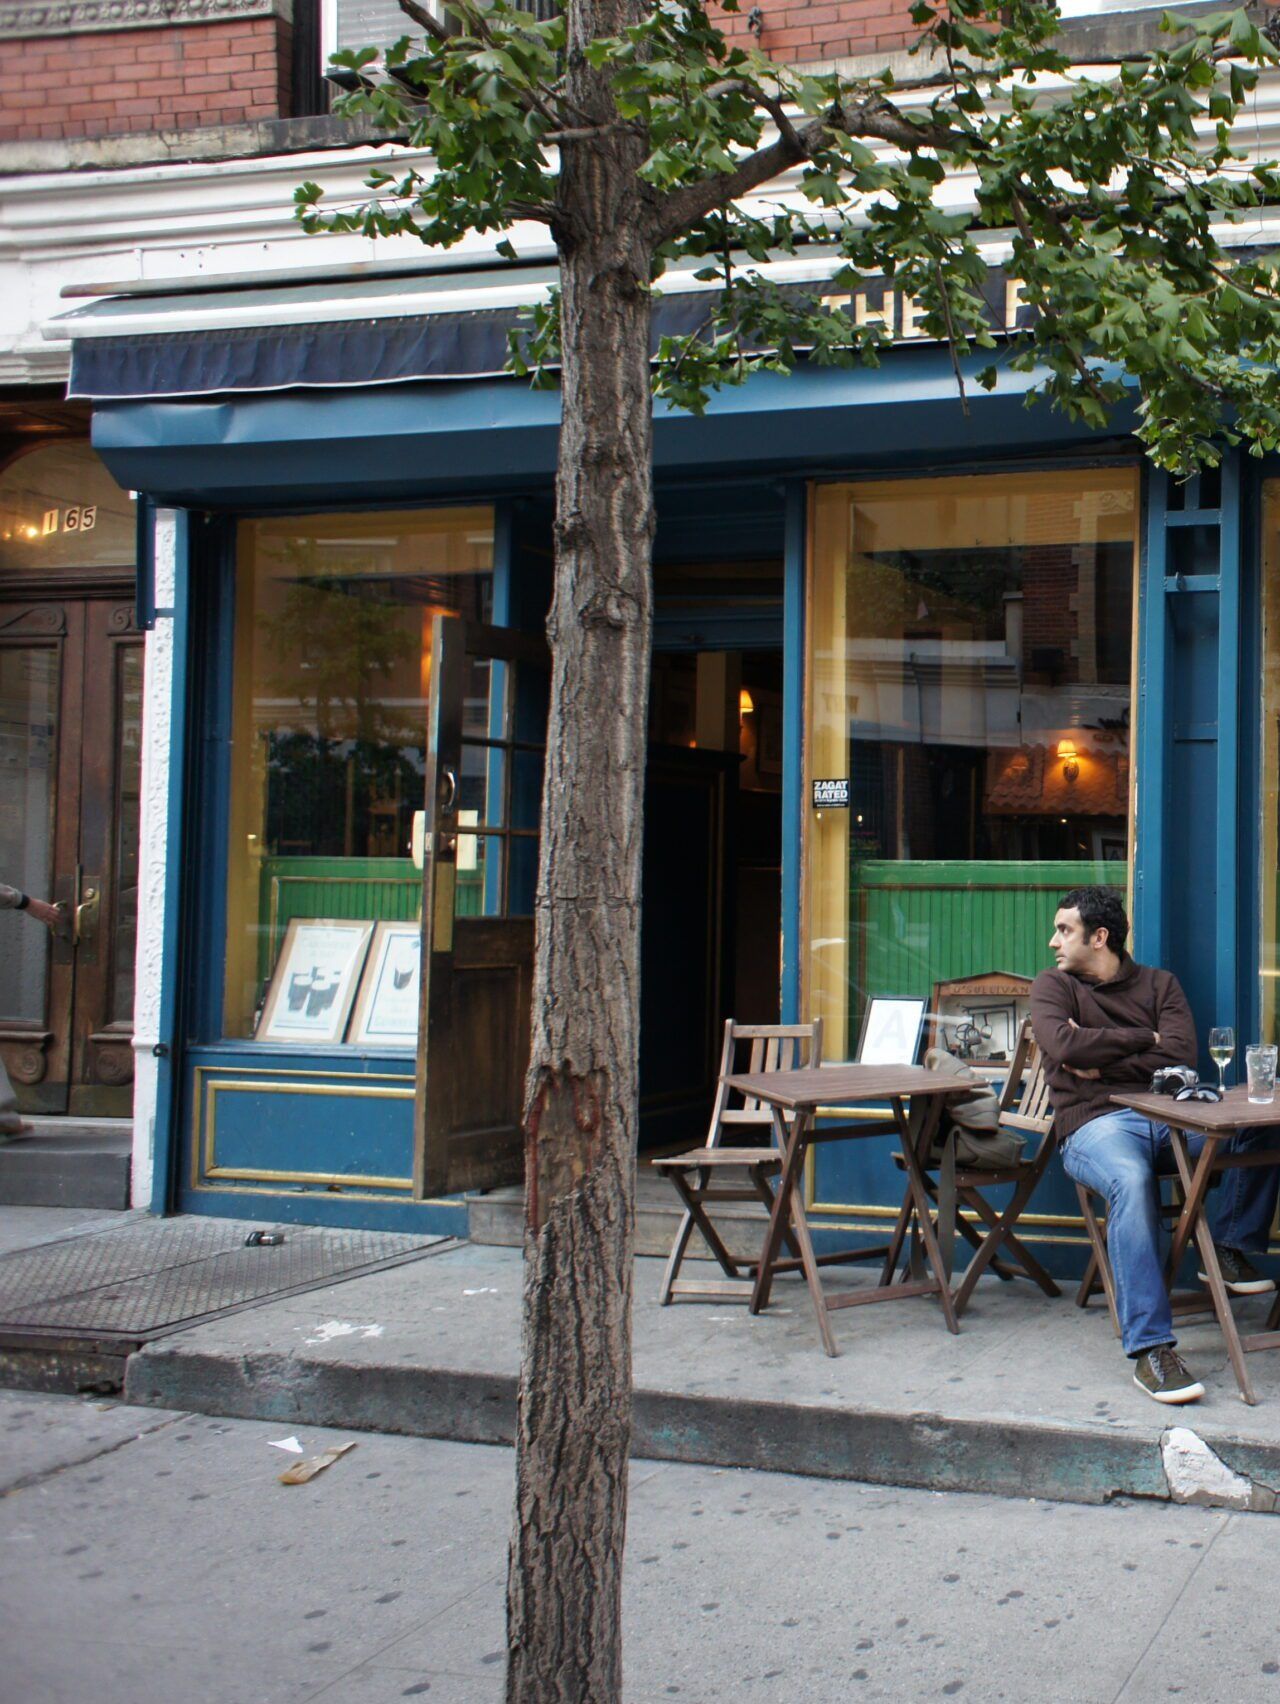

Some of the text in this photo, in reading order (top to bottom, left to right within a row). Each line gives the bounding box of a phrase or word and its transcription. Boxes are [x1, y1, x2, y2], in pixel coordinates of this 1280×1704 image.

[48, 508, 95, 531] 165
[814, 781, 848, 790] ZAGAT
[814, 790, 848, 799] RATED
[872, 1009, 908, 1050] A
